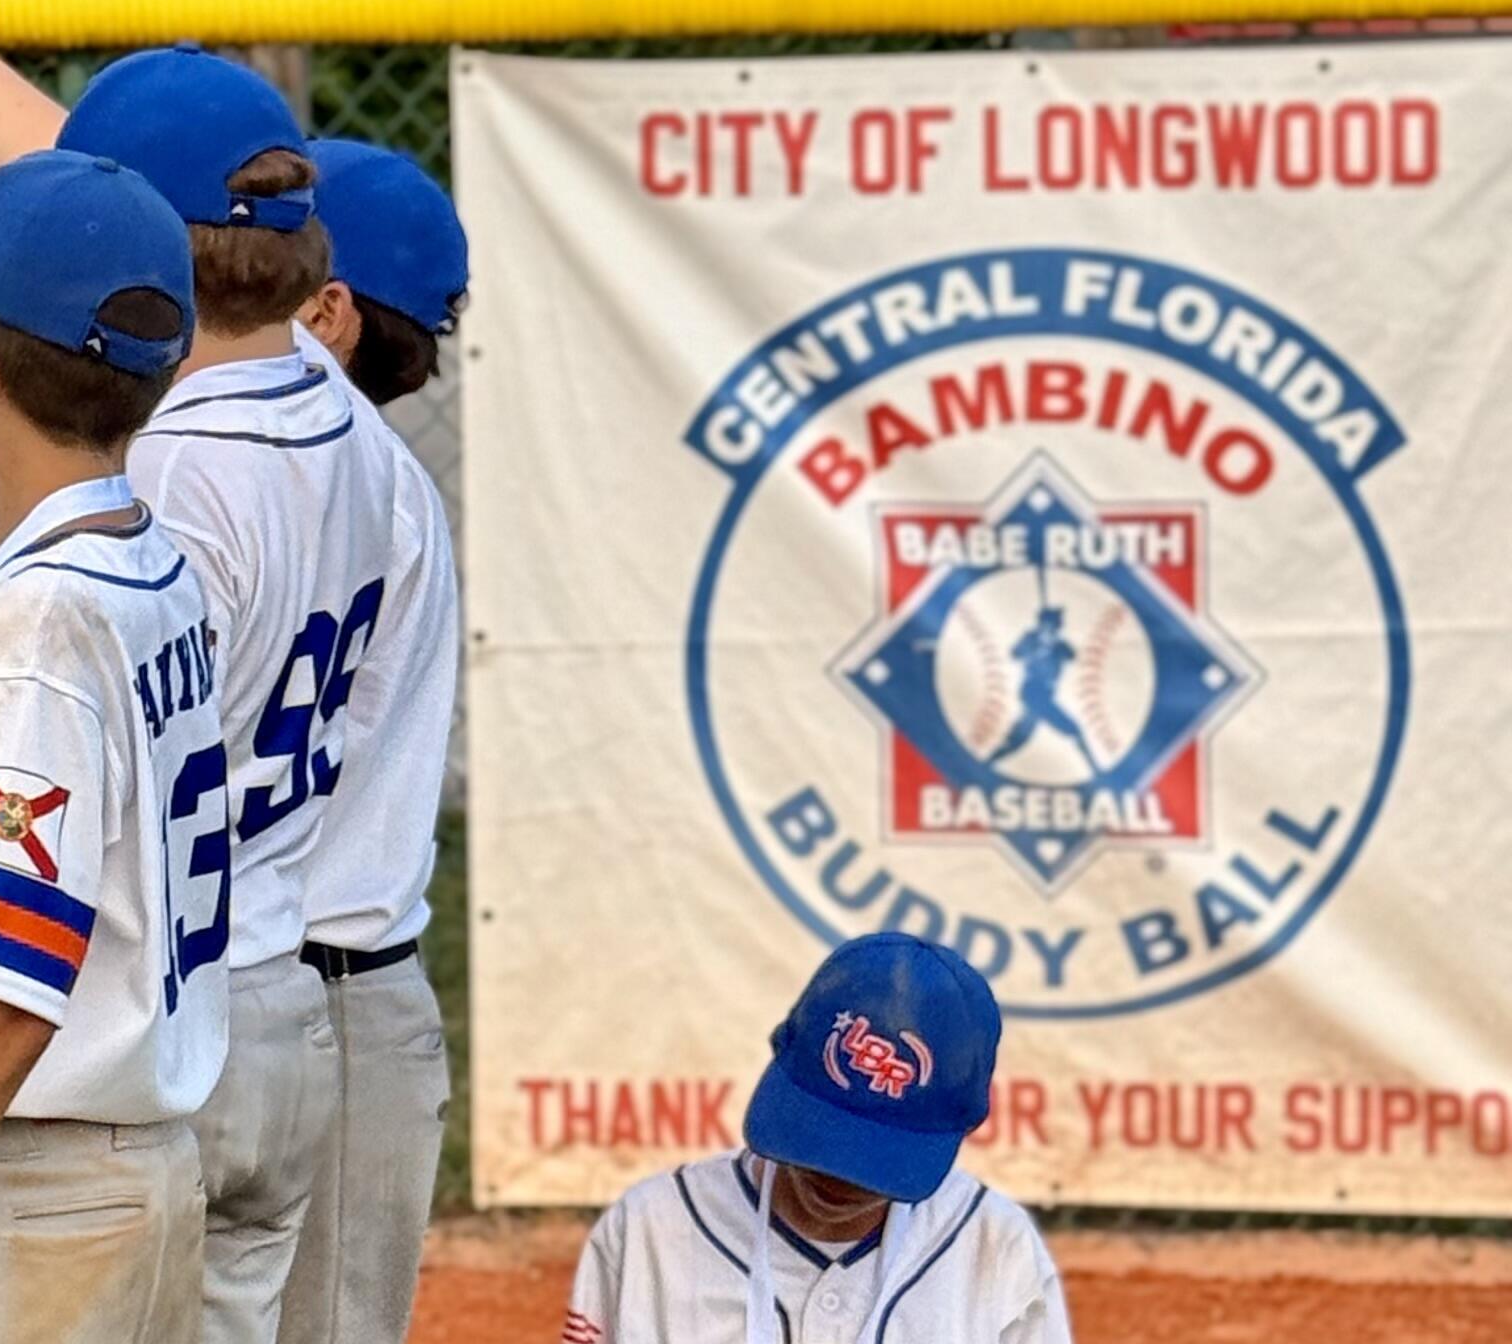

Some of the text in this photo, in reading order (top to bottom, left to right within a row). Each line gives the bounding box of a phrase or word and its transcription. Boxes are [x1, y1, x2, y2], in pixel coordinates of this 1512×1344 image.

[640, 98, 1441, 198] CITY OF LONGWOOD
[704, 259, 1380, 472] CENTRAL FLORIDA
[796, 359, 1275, 509] BAMBINO
[892, 520, 1187, 569] BABE RUTH
[919, 783, 1175, 834] BASEBALL
[765, 784, 1341, 988] BUDDY BALL
[517, 1078, 1512, 1157] THANK OR YOUR SUPPO
